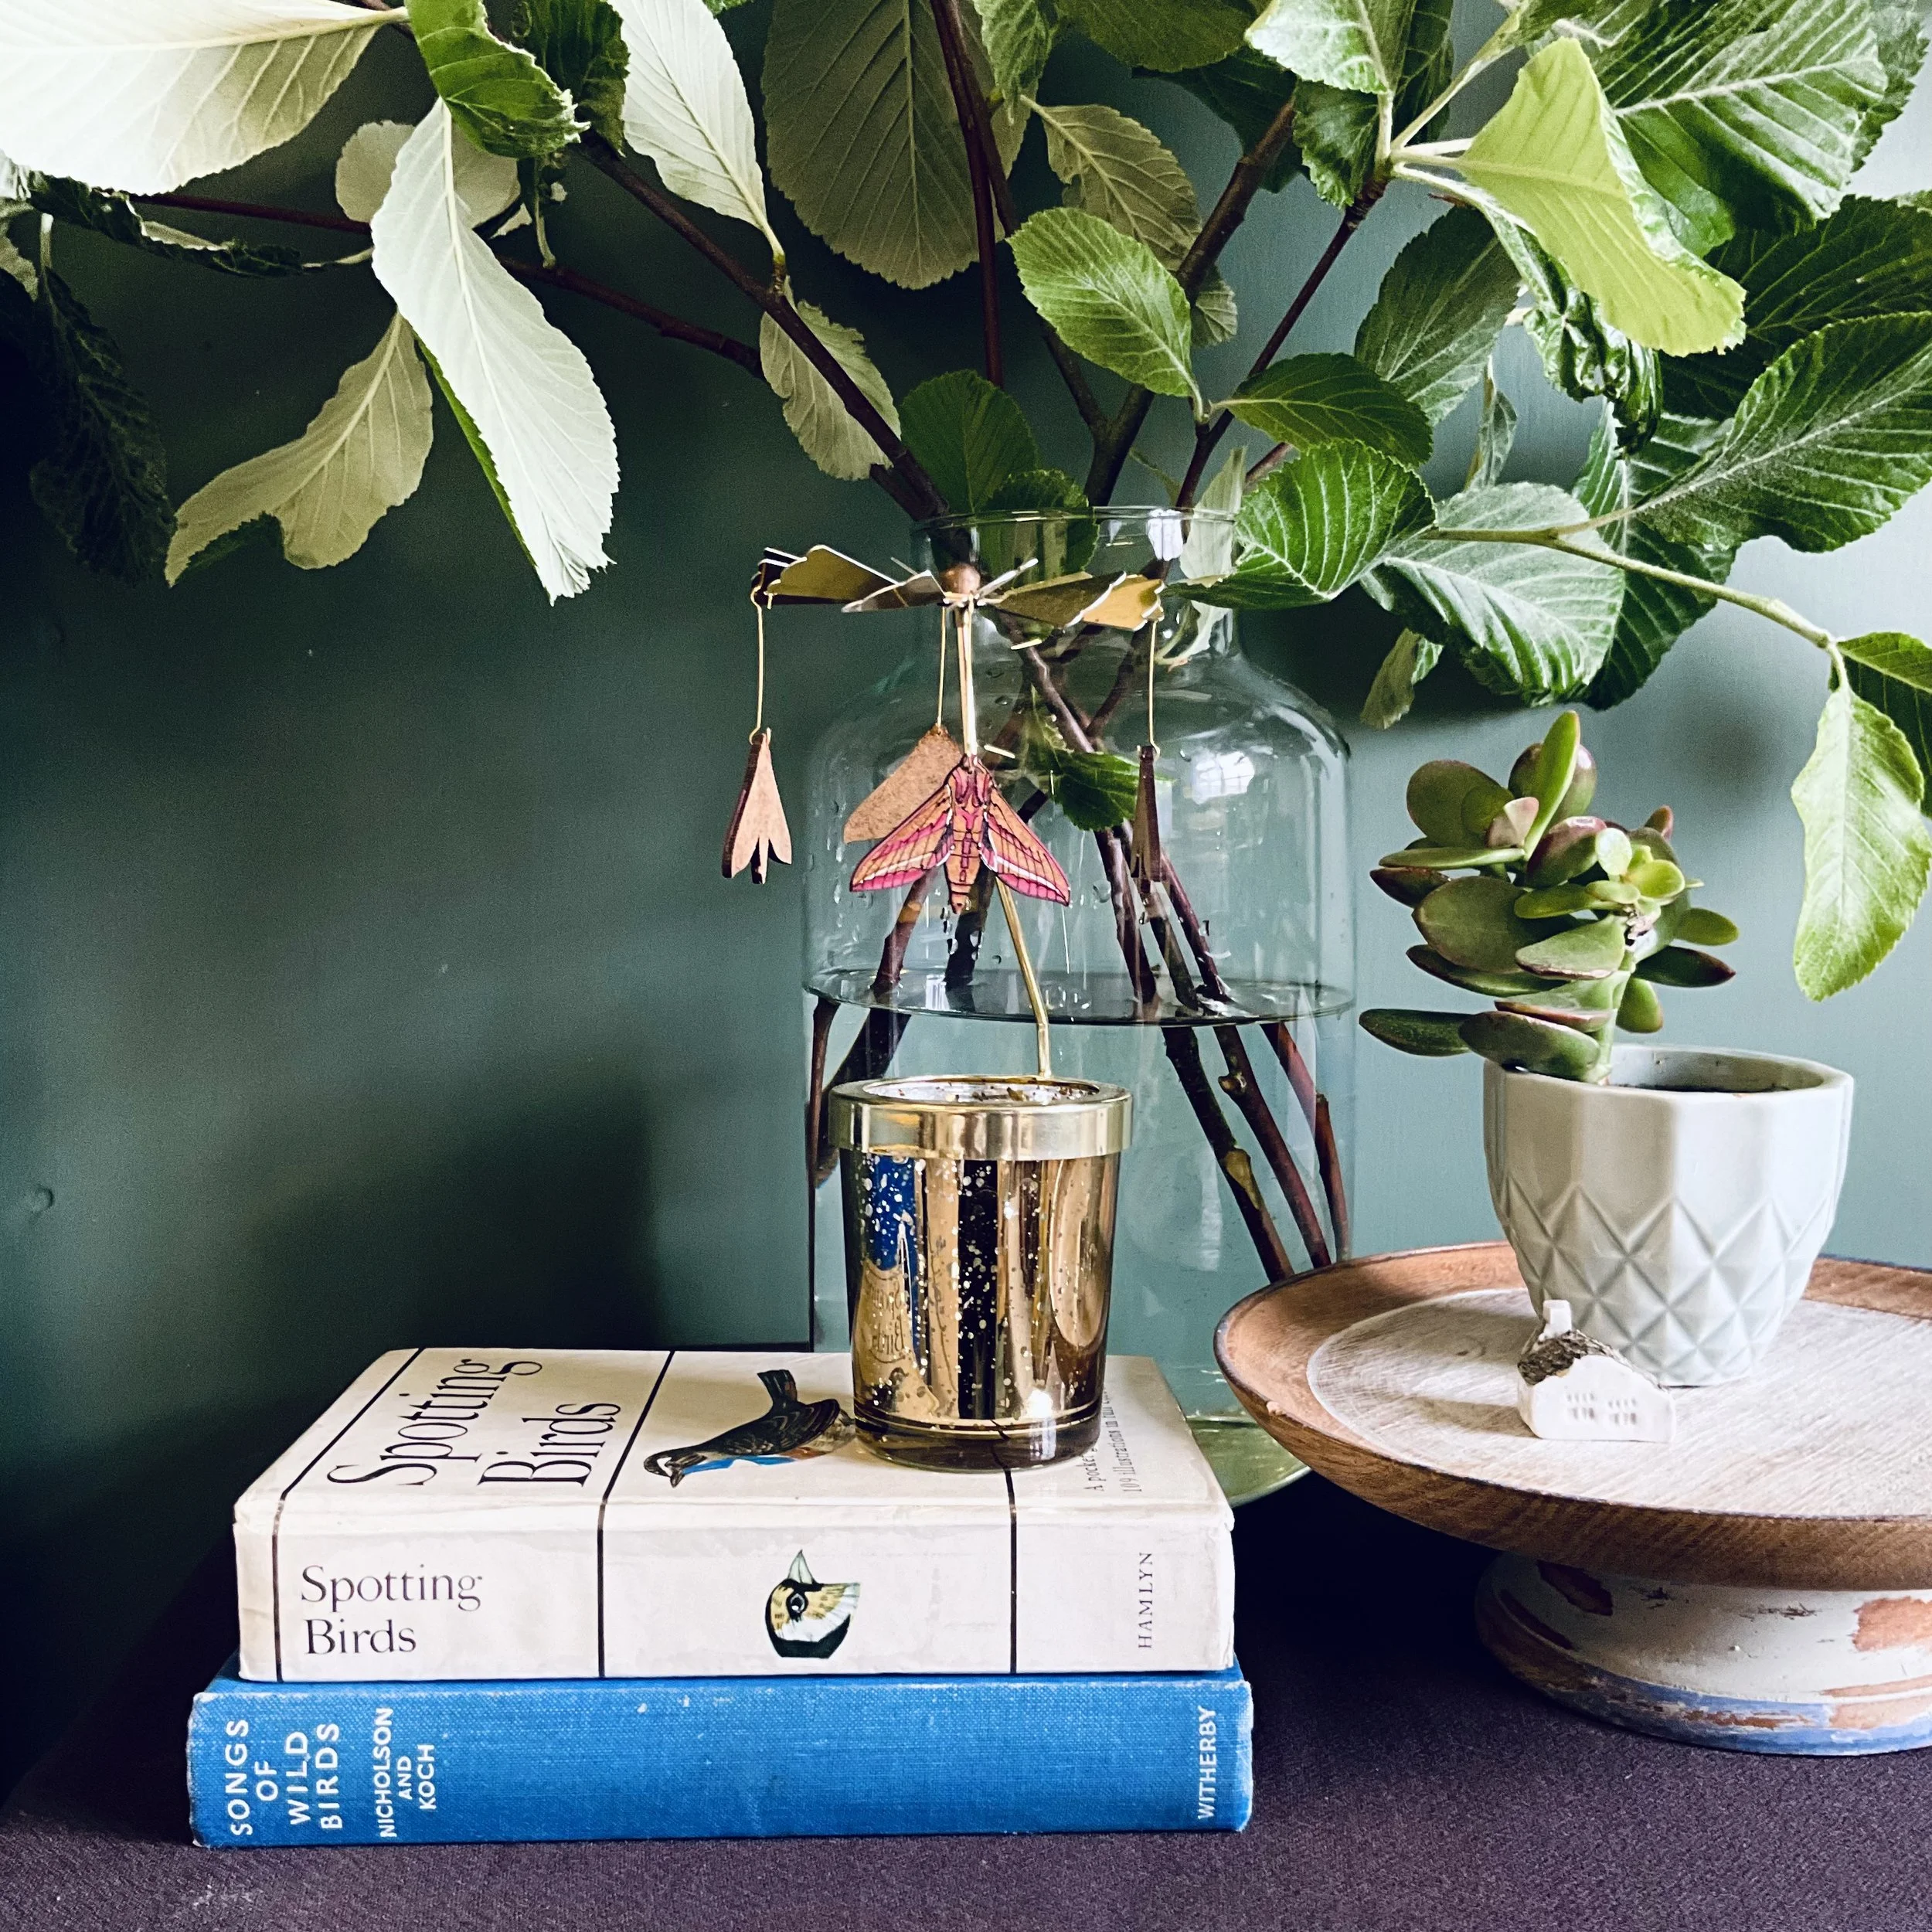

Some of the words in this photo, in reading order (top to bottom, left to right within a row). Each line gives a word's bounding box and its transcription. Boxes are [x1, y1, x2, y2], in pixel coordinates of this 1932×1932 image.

[326, 1358, 543, 1486] Spotting
[478, 1402, 621, 1487] Birds
[1107, 1430, 1136, 1475] illustrations
[1119, 1478, 1142, 1492] 109
[301, 1564, 483, 1613] Spotting
[1138, 1552, 1153, 1649] HAMLYN
[304, 1617, 417, 1655] Birds
[225, 1719, 253, 1836] SONGS
[254, 1760, 279, 1802] OF
[285, 1731, 311, 1825] WILD
[315, 1723, 343, 1830] BIRDS
[373, 1707, 397, 1838] NICHOLSON
[396, 1756, 413, 1801] AND
[417, 1743, 437, 1810] KOCH
[1198, 1705, 1217, 1820] WITHERBY
